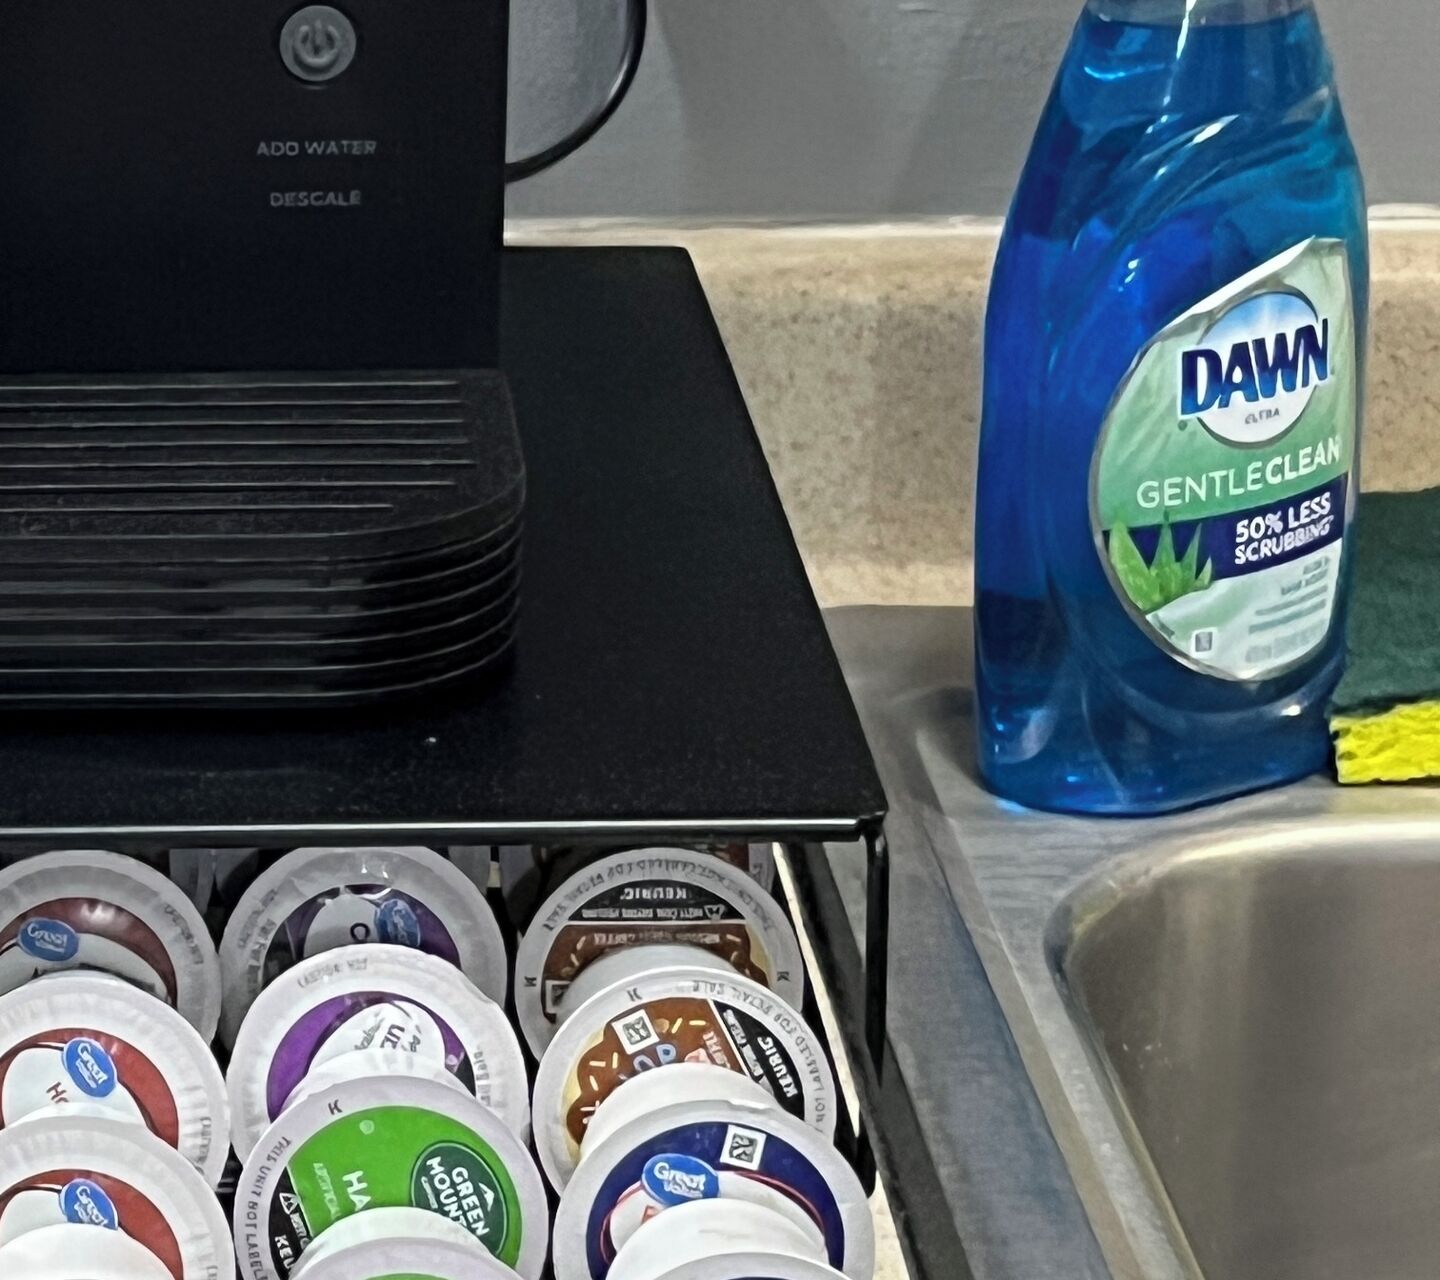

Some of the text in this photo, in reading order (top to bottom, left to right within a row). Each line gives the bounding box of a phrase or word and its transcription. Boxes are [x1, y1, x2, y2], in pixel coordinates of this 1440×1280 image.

[257, 140, 377, 157] ADD WATER
[270, 190, 362, 207] DESCALE
[1181, 319, 1329, 417] DAWN
[1235, 491, 1332, 545] 50% LESS
[653, 1162, 706, 1191] Great
[452, 1166, 490, 1238] GREEN
